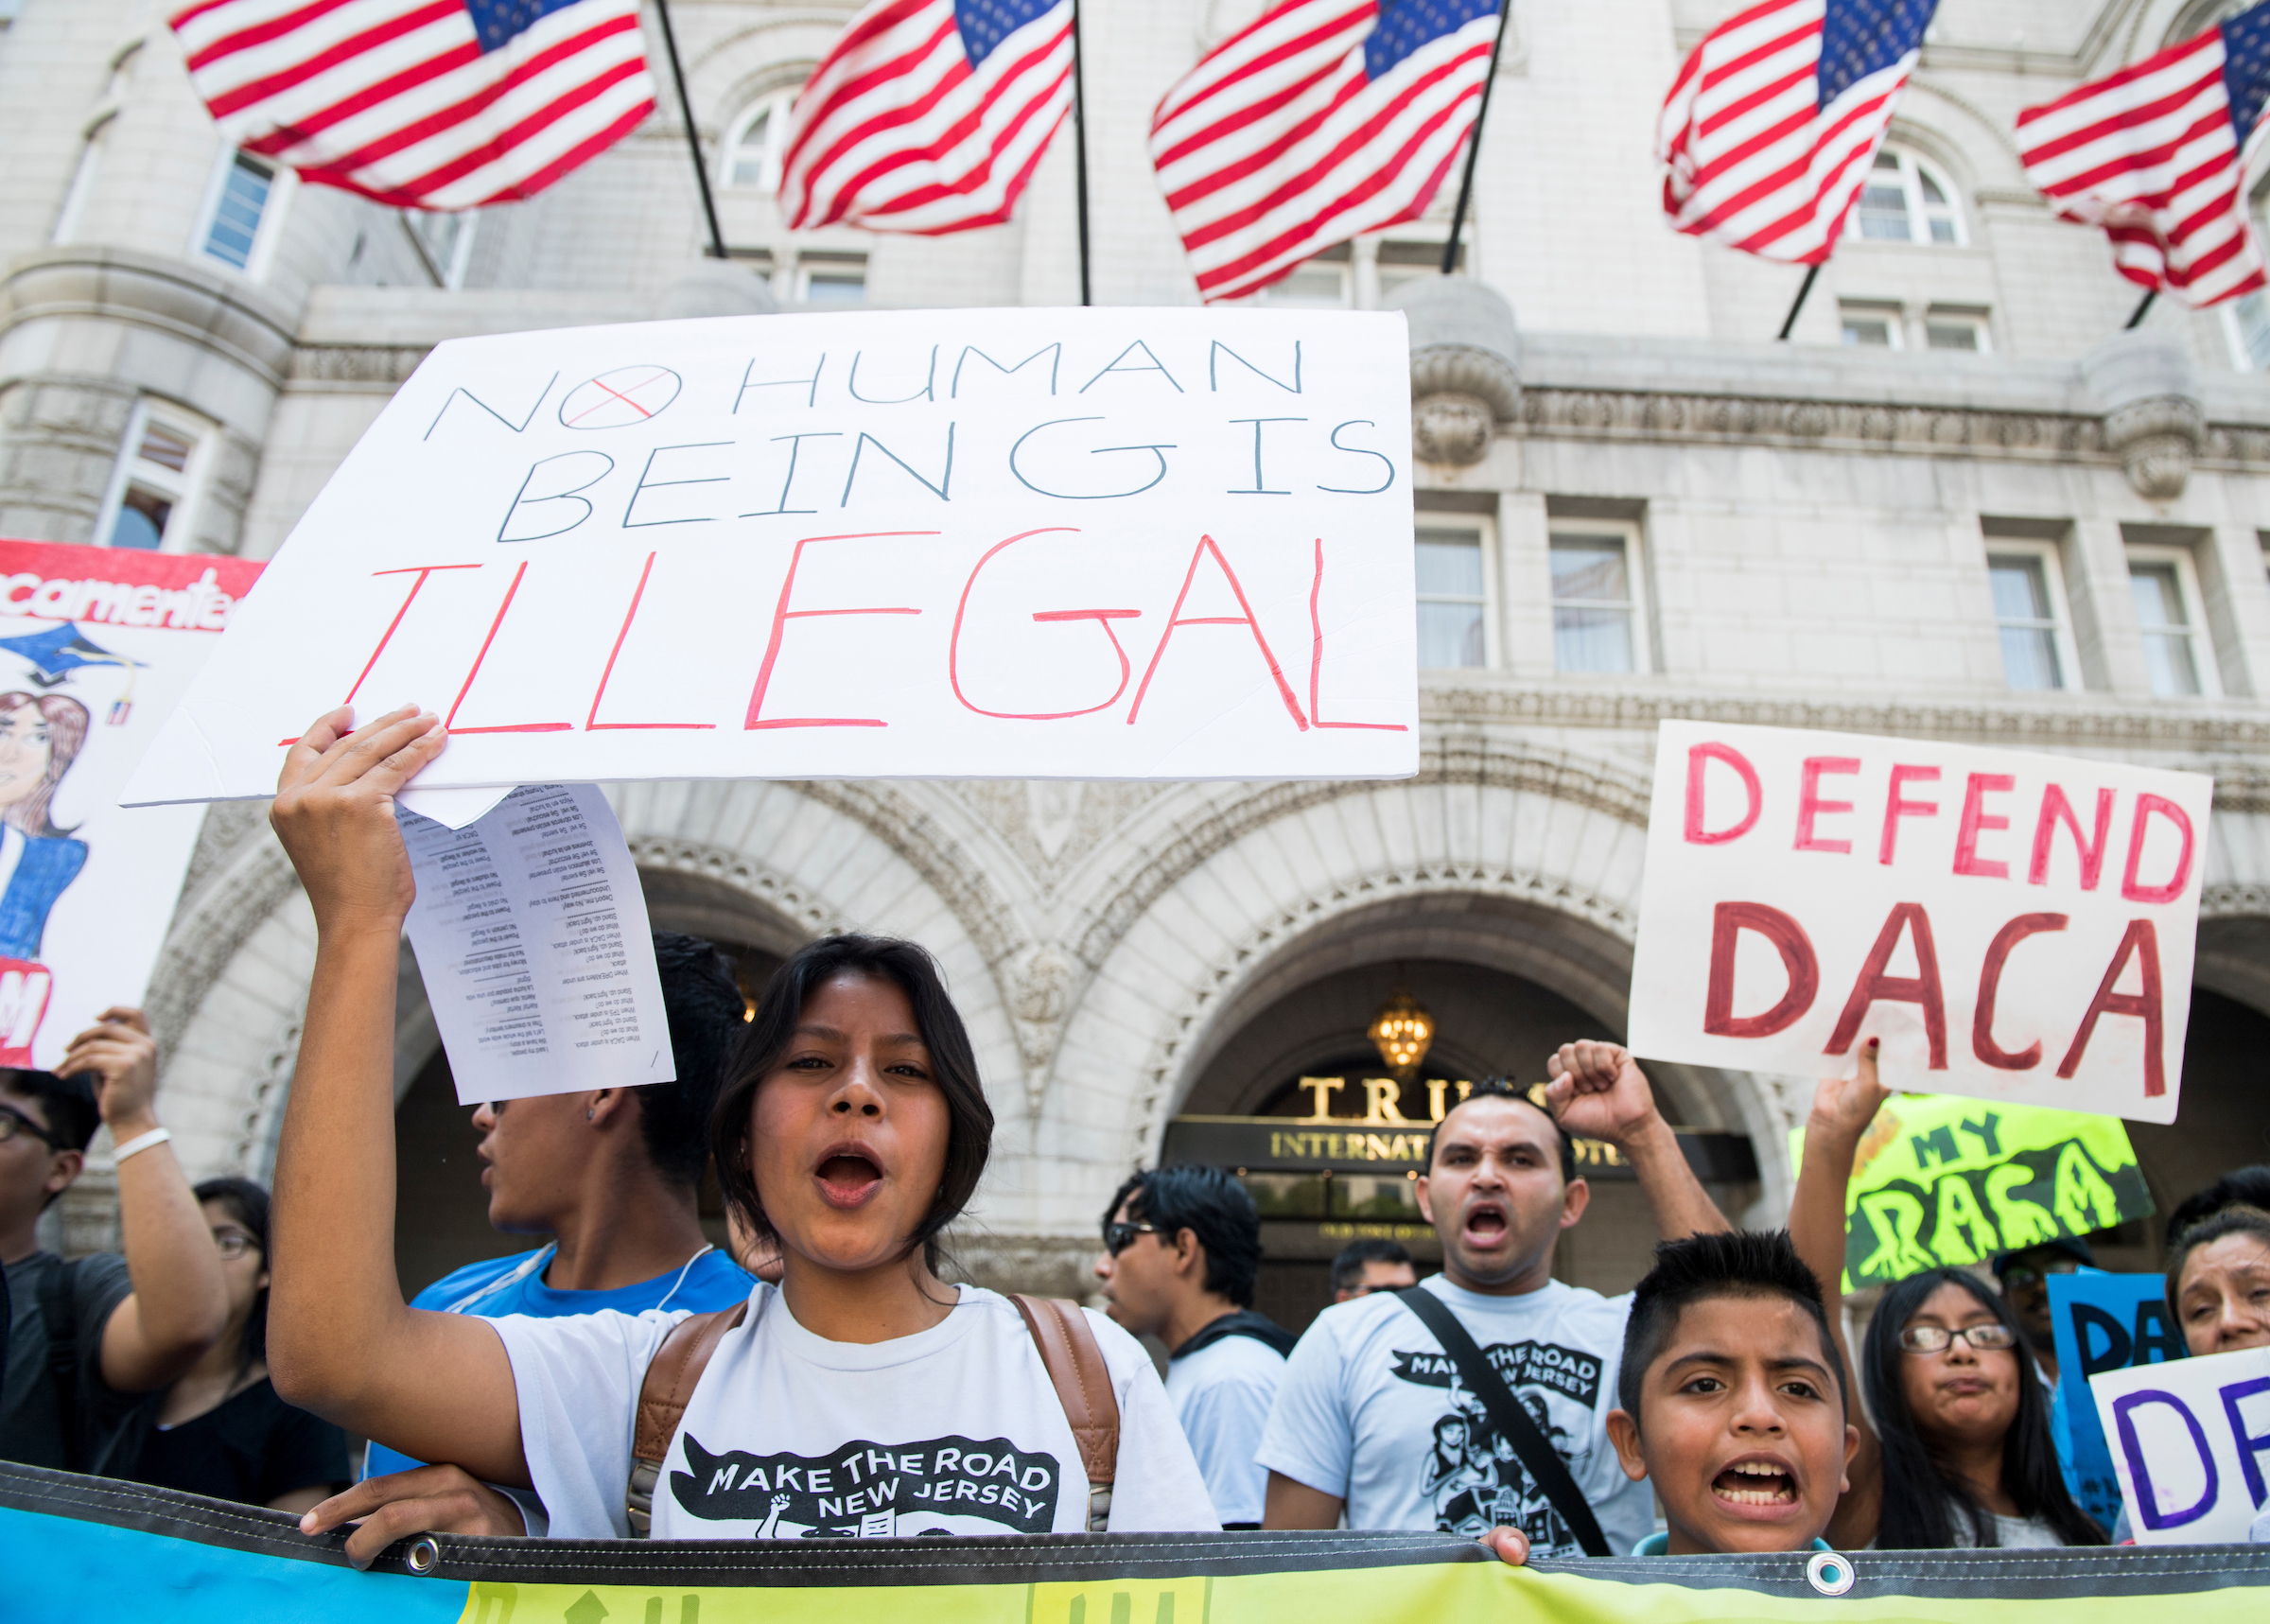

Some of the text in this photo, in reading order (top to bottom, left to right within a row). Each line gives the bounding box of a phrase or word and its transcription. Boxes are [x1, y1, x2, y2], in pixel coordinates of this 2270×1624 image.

[423, 339, 1302, 442] NO HUMAN
[497, 416, 1396, 542] BEING IS
[278, 528, 1409, 746] ILLEGAL
[1683, 742, 2195, 904] DEFEND
[569, 884, 611, 899] Undocumented
[594, 894, 613, 903] Deport
[580, 917, 592, 925] fight
[601, 912, 617, 921] Stand
[588, 934, 606, 943] DACA
[605, 931, 621, 939] When
[568, 937, 584, 946] under
[607, 940, 623, 949] Stand
[586, 944, 599, 952] fight
[611, 950, 625, 958] What
[585, 970, 613, 981] DREAMers
[596, 989, 608, 998] fight
[617, 987, 632, 995] Stand
[1703, 901, 2167, 1098] DACA
[608, 1008, 620, 1017] TPS
[602, 1018, 614, 1026] fight
[621, 1015, 637, 1023] Stand
[609, 1036, 625, 1044] DACA
[1911, 1111, 2002, 1170] MY
[1486, 1344, 1528, 1371] THE
[1529, 1345, 1598, 1381] ROAD
[1523, 1362, 1594, 1397] JERSEY
[706, 1447, 1052, 1495] MAKE THE ROAD
[817, 1476, 1046, 1521] NEW JERSEY
